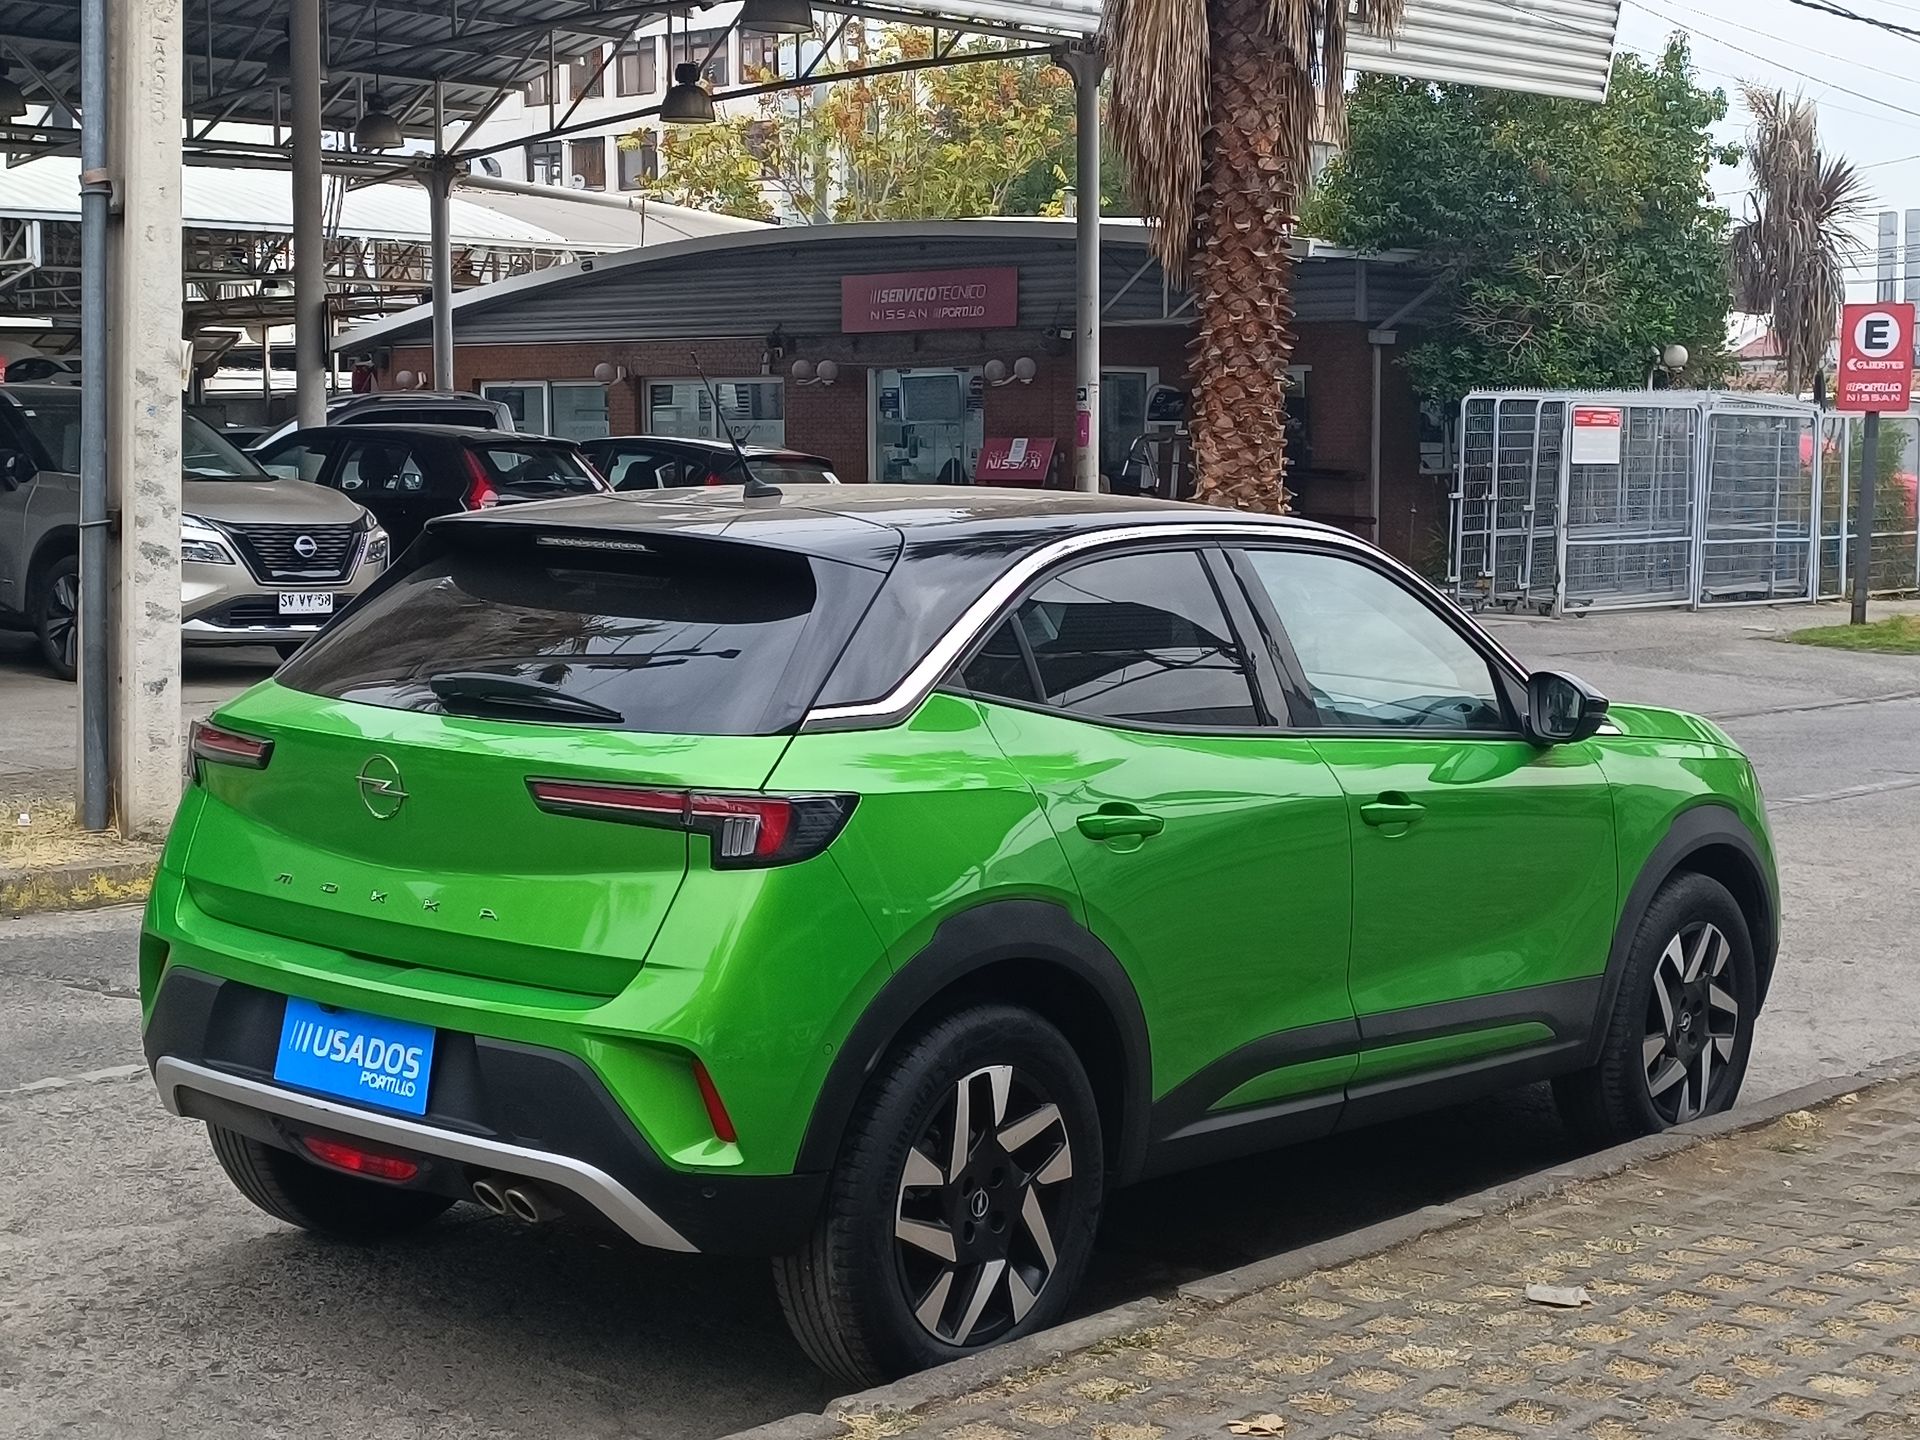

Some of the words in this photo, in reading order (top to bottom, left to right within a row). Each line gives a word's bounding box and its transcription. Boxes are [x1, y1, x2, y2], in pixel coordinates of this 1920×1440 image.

[880, 287, 937, 304] SERVICIO
[870, 308, 928, 321] NISSAN
[1865, 320, 1890, 350] E
[1846, 393, 1901, 402] NISSAN
[274, 872, 498, 921] MOKKA
[312, 1025, 424, 1080] USADOS
[359, 1071, 417, 1098] PORTILLO
